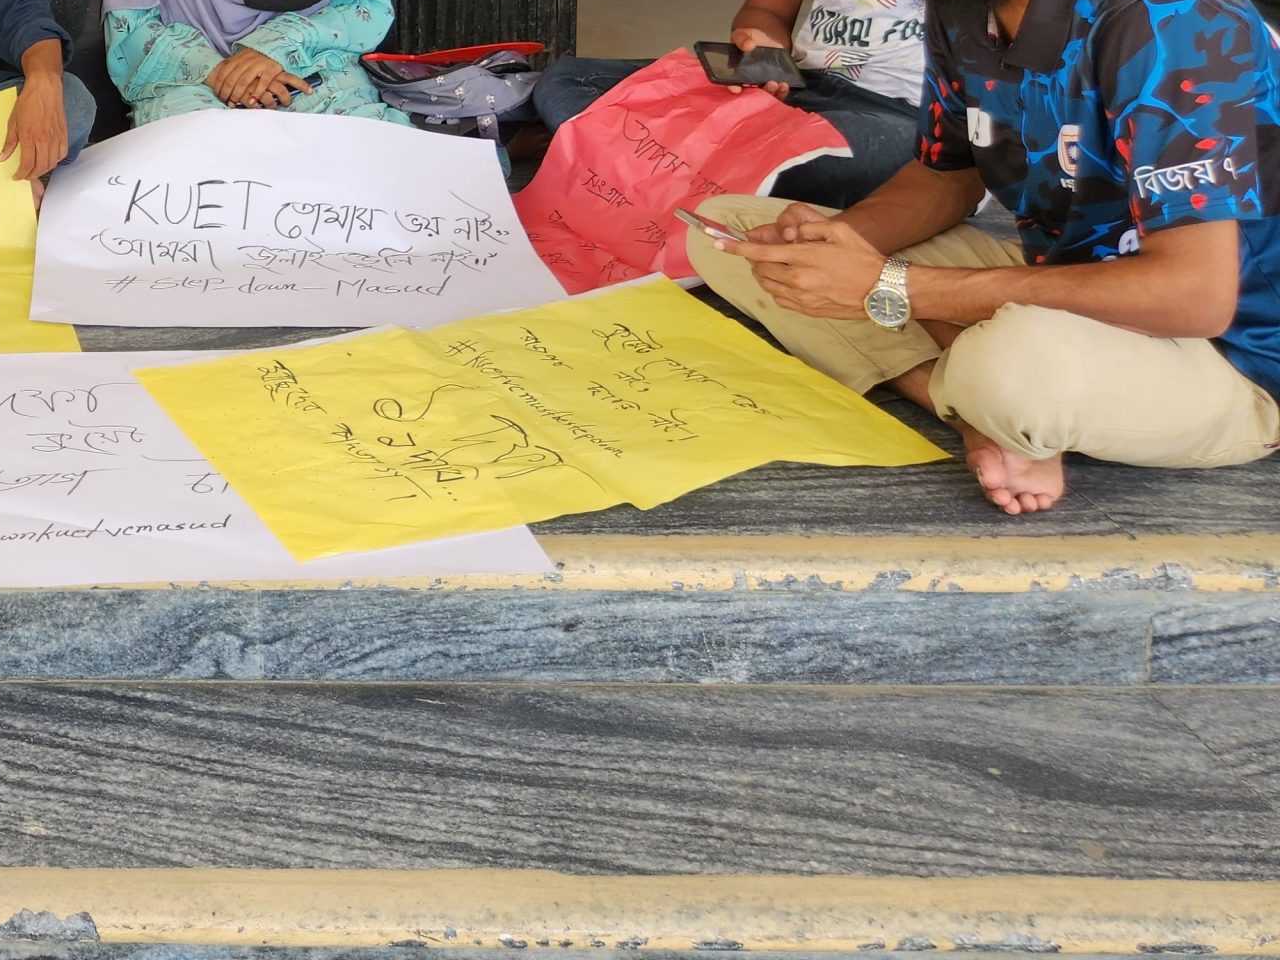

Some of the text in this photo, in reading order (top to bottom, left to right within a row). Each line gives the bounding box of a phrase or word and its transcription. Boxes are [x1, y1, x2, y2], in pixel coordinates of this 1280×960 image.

[810, 4, 873, 48] ATURAL
[1133, 159, 1217, 198] বিজয়
[274, 201, 389, 243] তোমার
